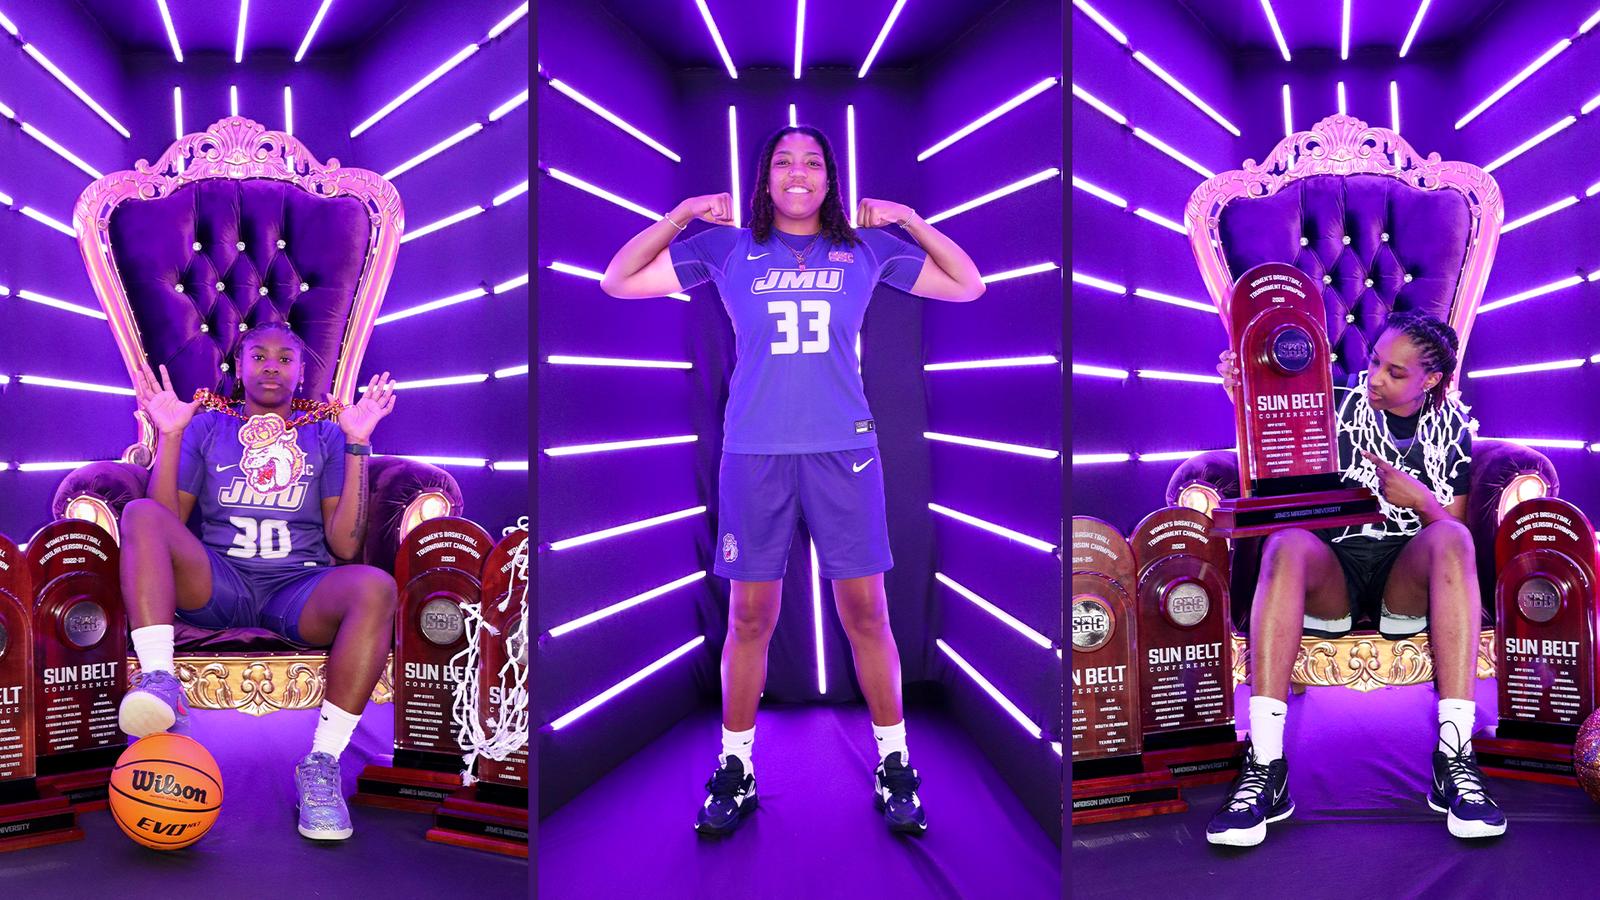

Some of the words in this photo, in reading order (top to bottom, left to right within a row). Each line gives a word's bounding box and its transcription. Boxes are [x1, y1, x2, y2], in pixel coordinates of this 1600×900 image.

[752, 269, 843, 293] JMU
[1250, 275, 1272, 288] WOMEN'S
[1273, 275, 1302, 288] BASKETBALL
[1249, 284, 1281, 299] TOURNAMENT
[1282, 284, 1306, 299] CHAMPION
[768, 300, 831, 355] 33
[1257, 394, 1289, 411] SUN
[1291, 392, 1325, 410] BELT
[1259, 411, 1324, 419] CONFERENCE
[219, 478, 307, 511] JMU
[1312, 506, 1341, 515] UNIVERSITY
[1516, 512, 1539, 525] WOMEN'S
[1540, 511, 1572, 526] BASKETBALL
[1150, 522, 1173, 535] WOMEN'S
[1174, 520, 1206, 533] BASKETBALL
[1510, 525, 1532, 540] REGULAR
[1554, 522, 1579, 541] CHAMPION
[45, 533, 69, 549] WOMEN'S
[70, 533, 101, 546] BASKETBALL
[227, 516, 292, 559] 30
[418, 531, 443, 545] WOMEN'S
[444, 531, 478, 547] BASKETBALL
[1148, 530, 1182, 547] TOURNAMENT
[1182, 530, 1208, 544] CHAMPION
[39, 547, 61, 565] REGULAR
[62, 544, 84, 552] SEASON
[84, 544, 108, 562] CHAMPION
[416, 542, 452, 557] TOURNAMENT
[453, 542, 481, 560] CHAMPION
[1090, 541, 1118, 560] CHAMPION
[1173, 596, 1204, 614] SBC
[425, 612, 459, 630] SBC
[1148, 646, 1181, 665] SUN
[1186, 642, 1222, 661] BELT
[1506, 638, 1538, 655] SUN
[1542, 640, 1580, 658] BELT
[1150, 660, 1220, 673] CONFERENCE
[1506, 656, 1577, 666] CONFERENCE
[44, 666, 77, 685] SUN
[81, 662, 118, 681] BELT
[405, 662, 439, 681] SUN
[443, 666, 475, 682] BE
[1086, 665, 1126, 686] BELT
[45, 680, 115, 693] CONFERENCE
[132, 769, 207, 804] Wilson
[1074, 799, 1098, 808] MADISON
[1098, 795, 1130, 806] UNIVERSITY
[0, 823, 30, 834] NIVERSITY
[137, 817, 187, 836] EVO
